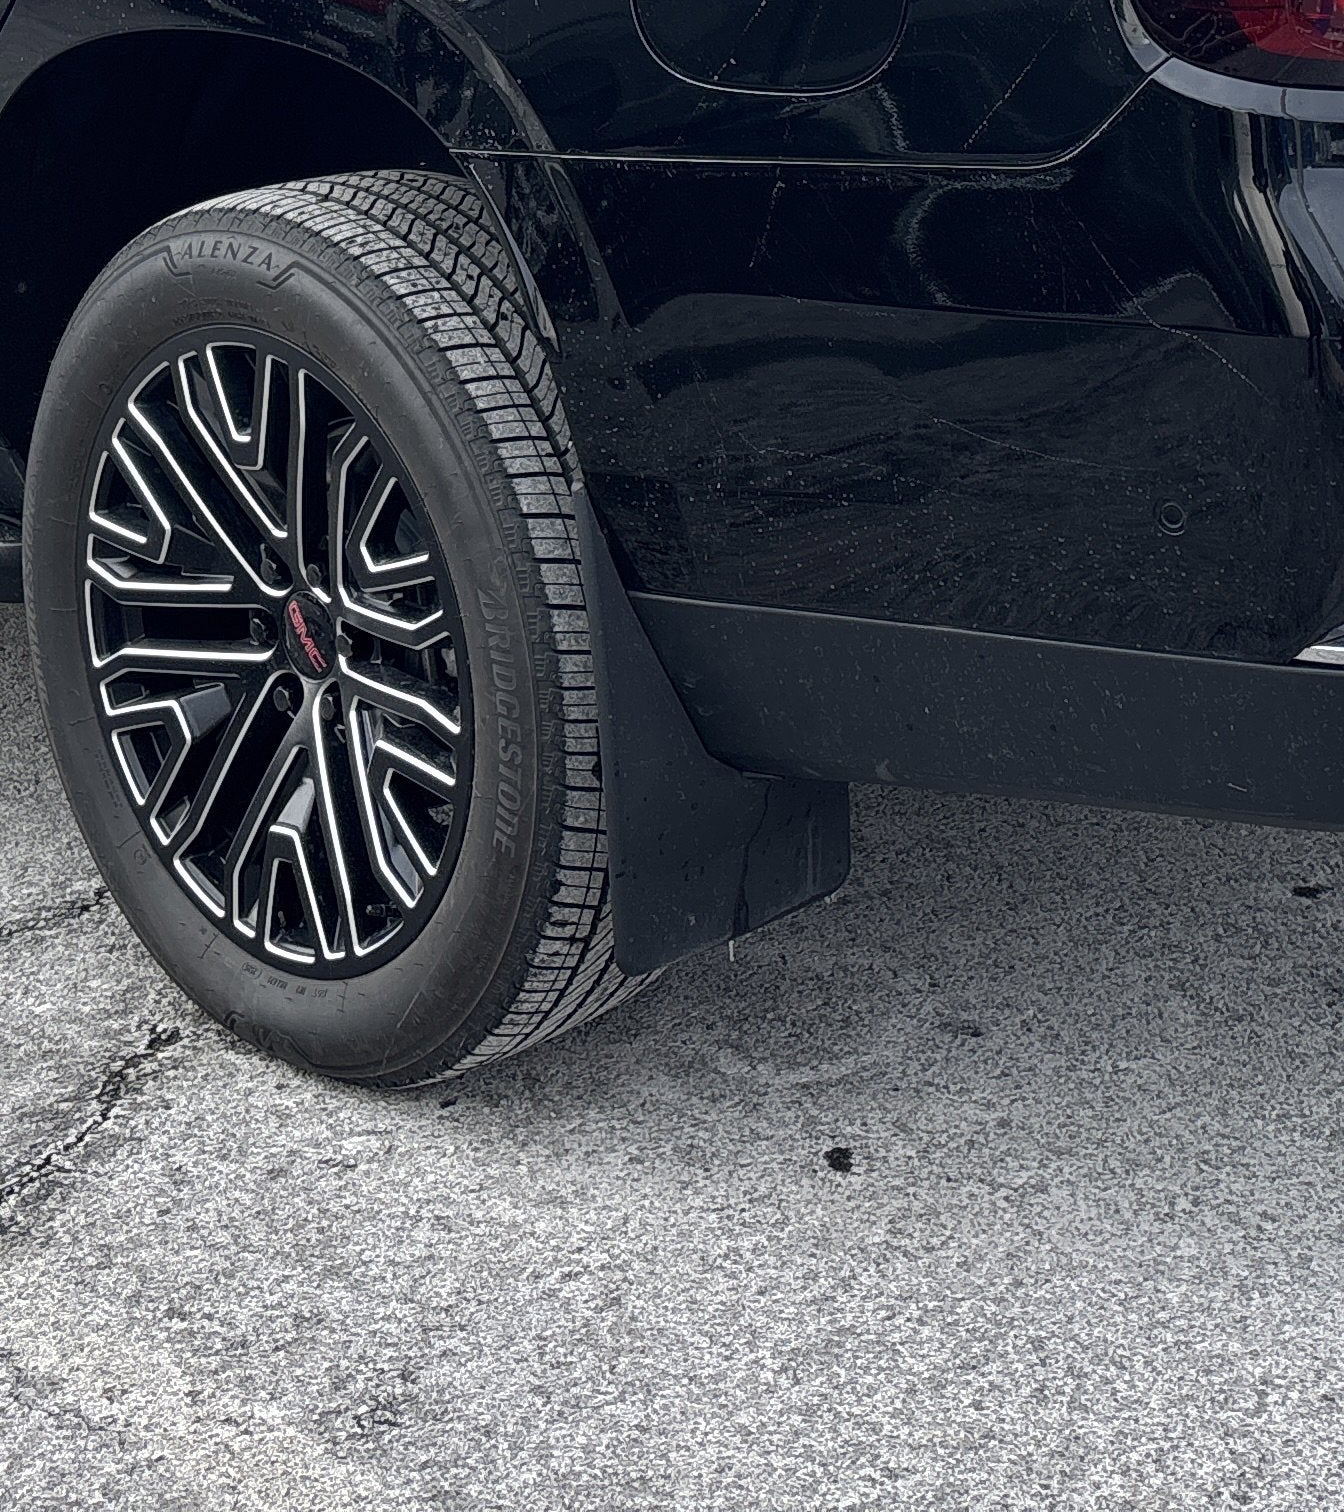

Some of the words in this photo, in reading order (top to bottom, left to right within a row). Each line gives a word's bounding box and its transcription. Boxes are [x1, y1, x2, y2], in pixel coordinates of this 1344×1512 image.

[180, 239, 274, 272] ALENZA
[288, 599, 328, 674] GMC
[477, 588, 522, 858] BRIDGESTONE
